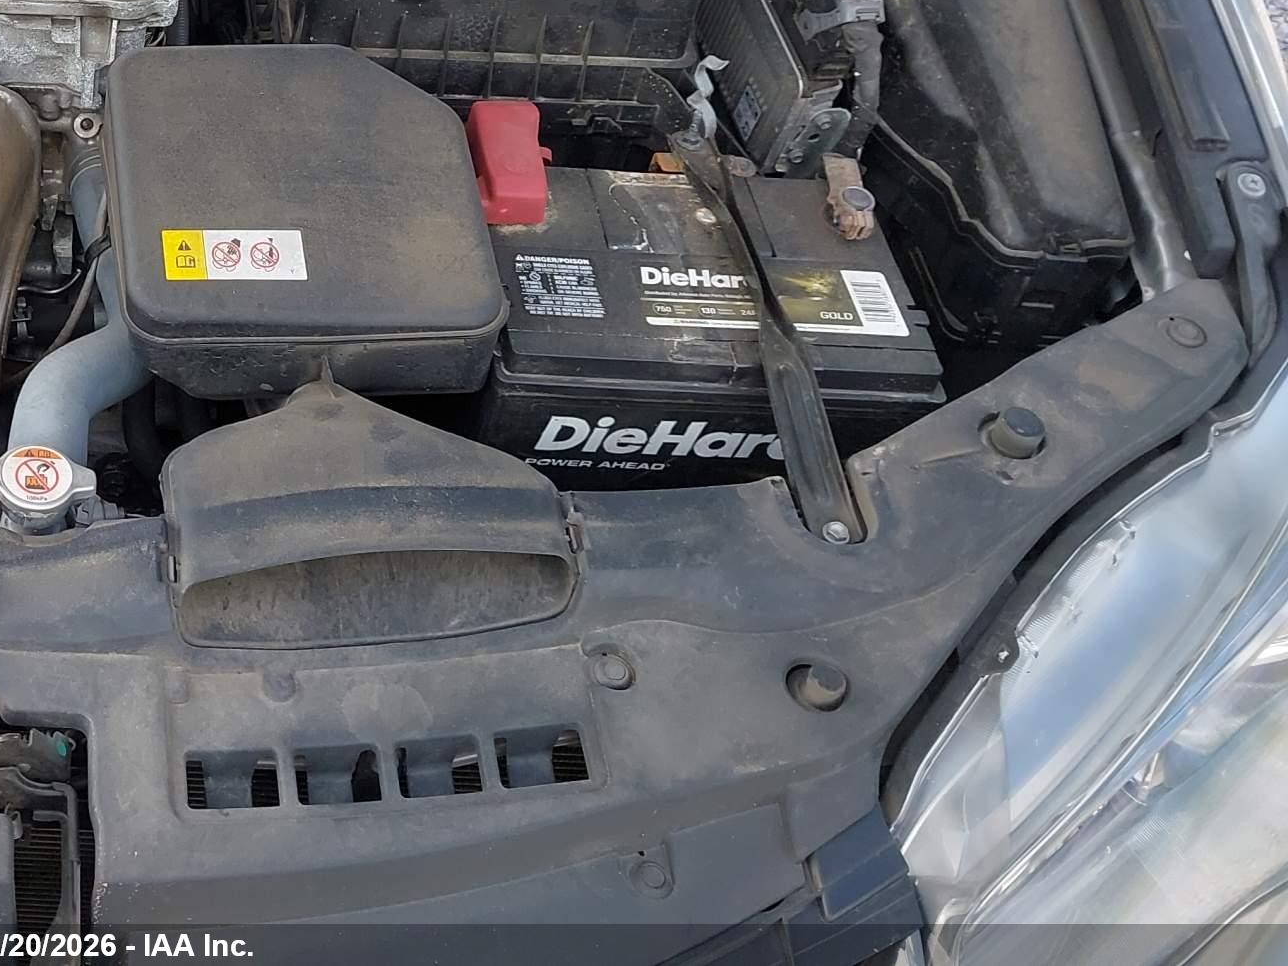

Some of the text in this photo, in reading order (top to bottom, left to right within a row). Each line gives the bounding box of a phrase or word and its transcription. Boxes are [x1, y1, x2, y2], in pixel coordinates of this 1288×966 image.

[639, 266, 748, 289] DieHar
[819, 310, 854, 321] GOLD
[523, 457, 666, 471] POWER AHEAD
